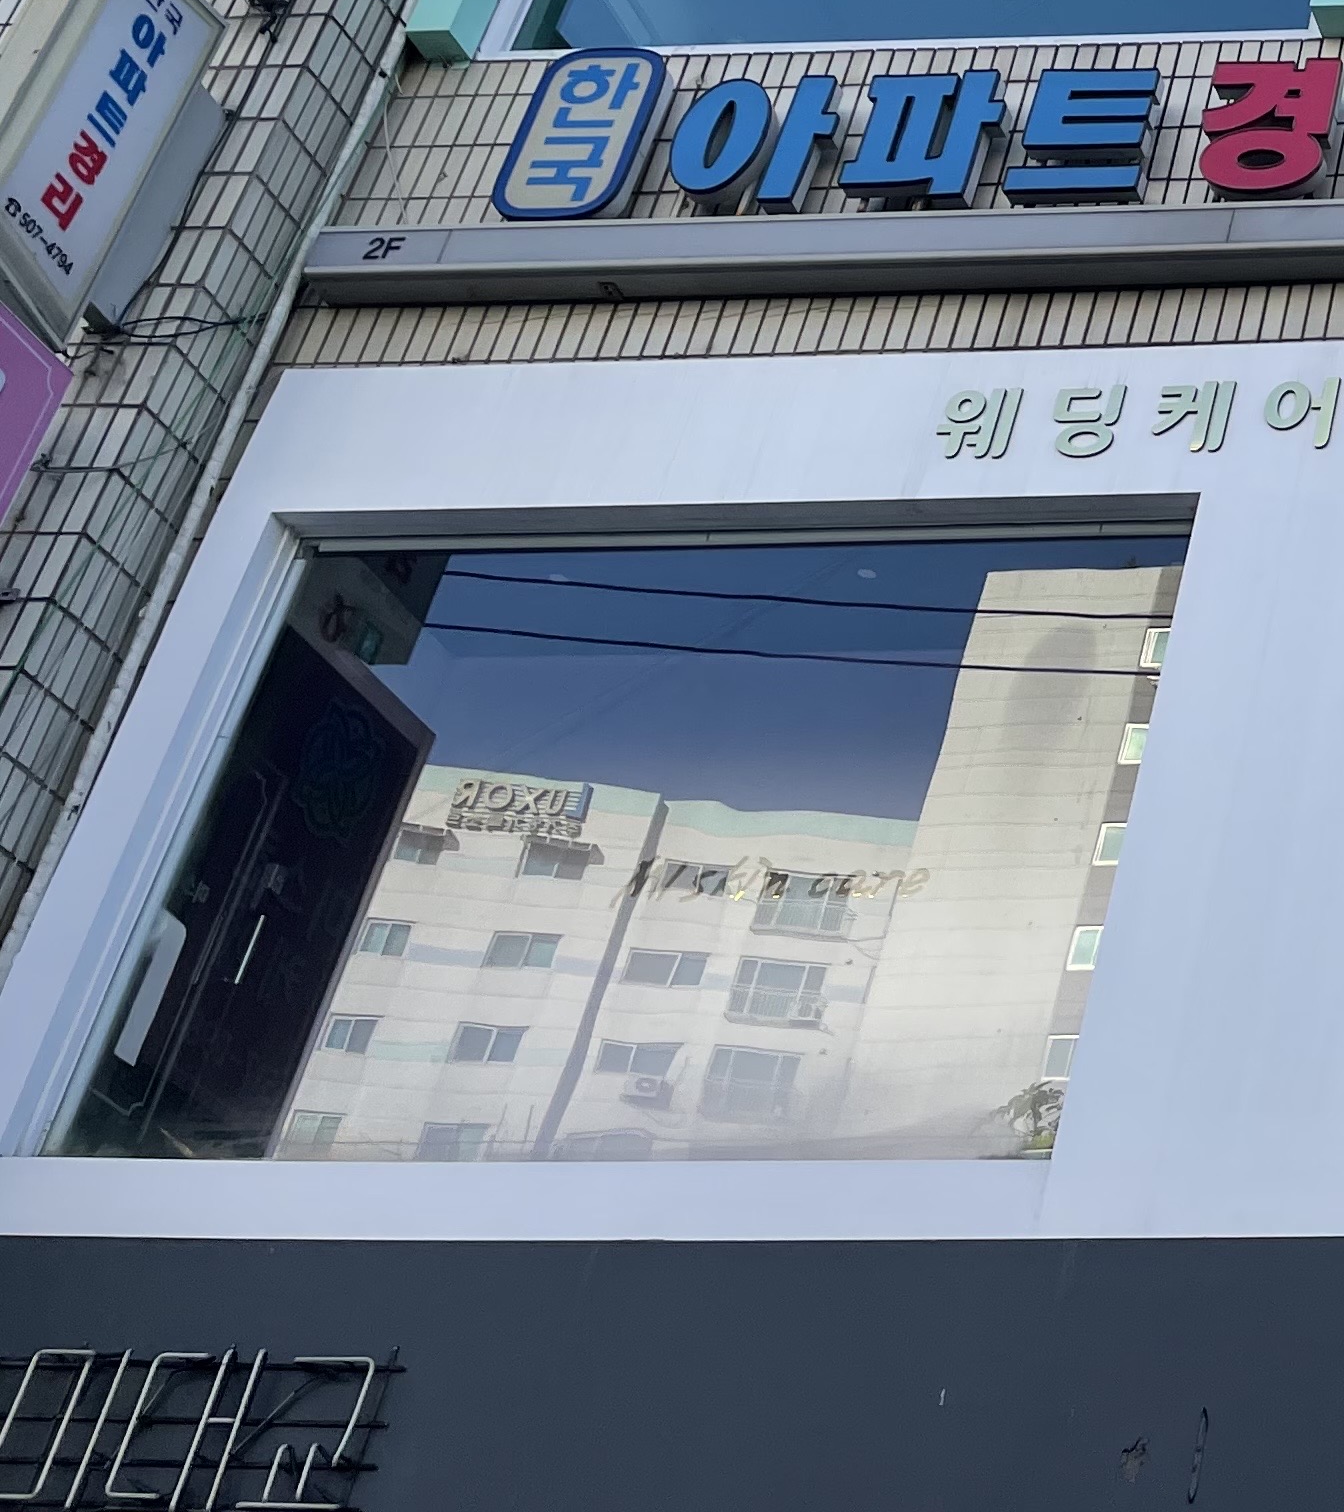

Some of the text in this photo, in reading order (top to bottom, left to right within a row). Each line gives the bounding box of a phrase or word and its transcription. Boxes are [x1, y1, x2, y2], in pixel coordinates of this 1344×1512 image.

[526, 62, 640, 201] 한국
[19, 211, 74, 276] 507-4794
[362, 237, 406, 260] 2F
